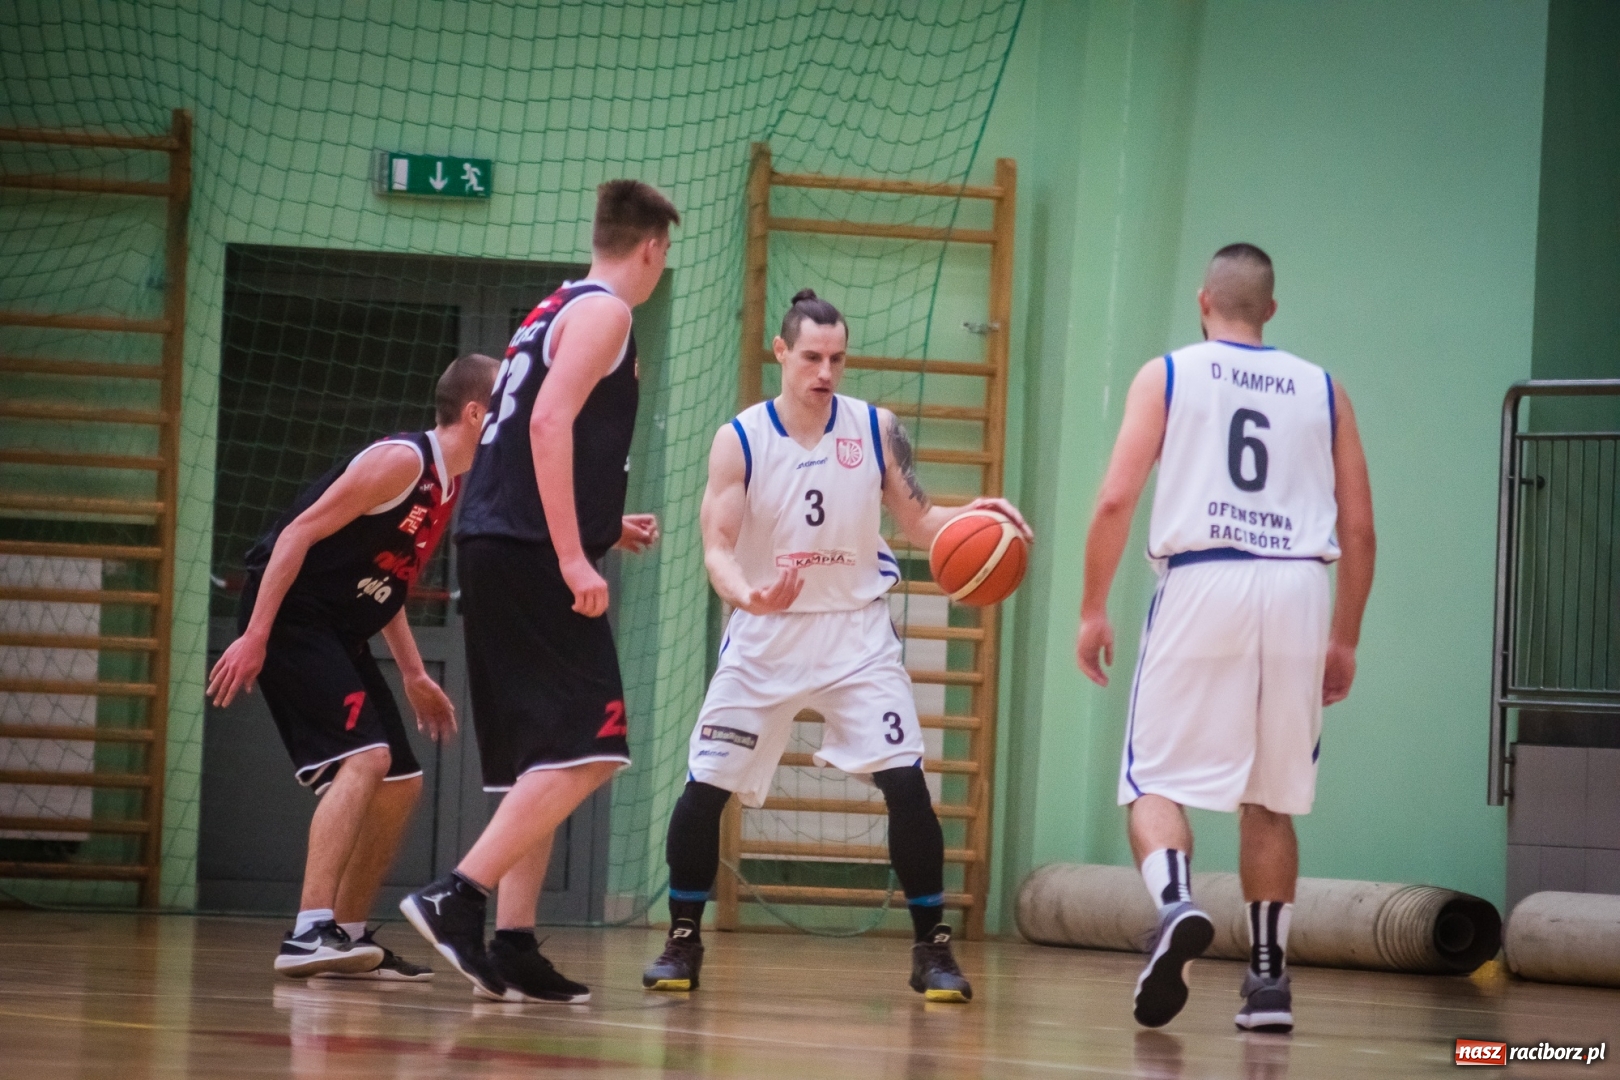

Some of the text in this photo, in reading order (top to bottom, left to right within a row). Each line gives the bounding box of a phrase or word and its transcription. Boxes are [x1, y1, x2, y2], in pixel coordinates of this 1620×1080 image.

[1211, 362, 1297, 396] D. KAMPKA
[1228, 407, 1271, 493] 6
[804, 489, 826, 527] 3
[1208, 501, 1293, 530] OFENSYWA
[1209, 524, 1294, 551] RACIBÓRZ
[795, 553, 845, 567] KAMPKA
[882, 711, 905, 745] 3
